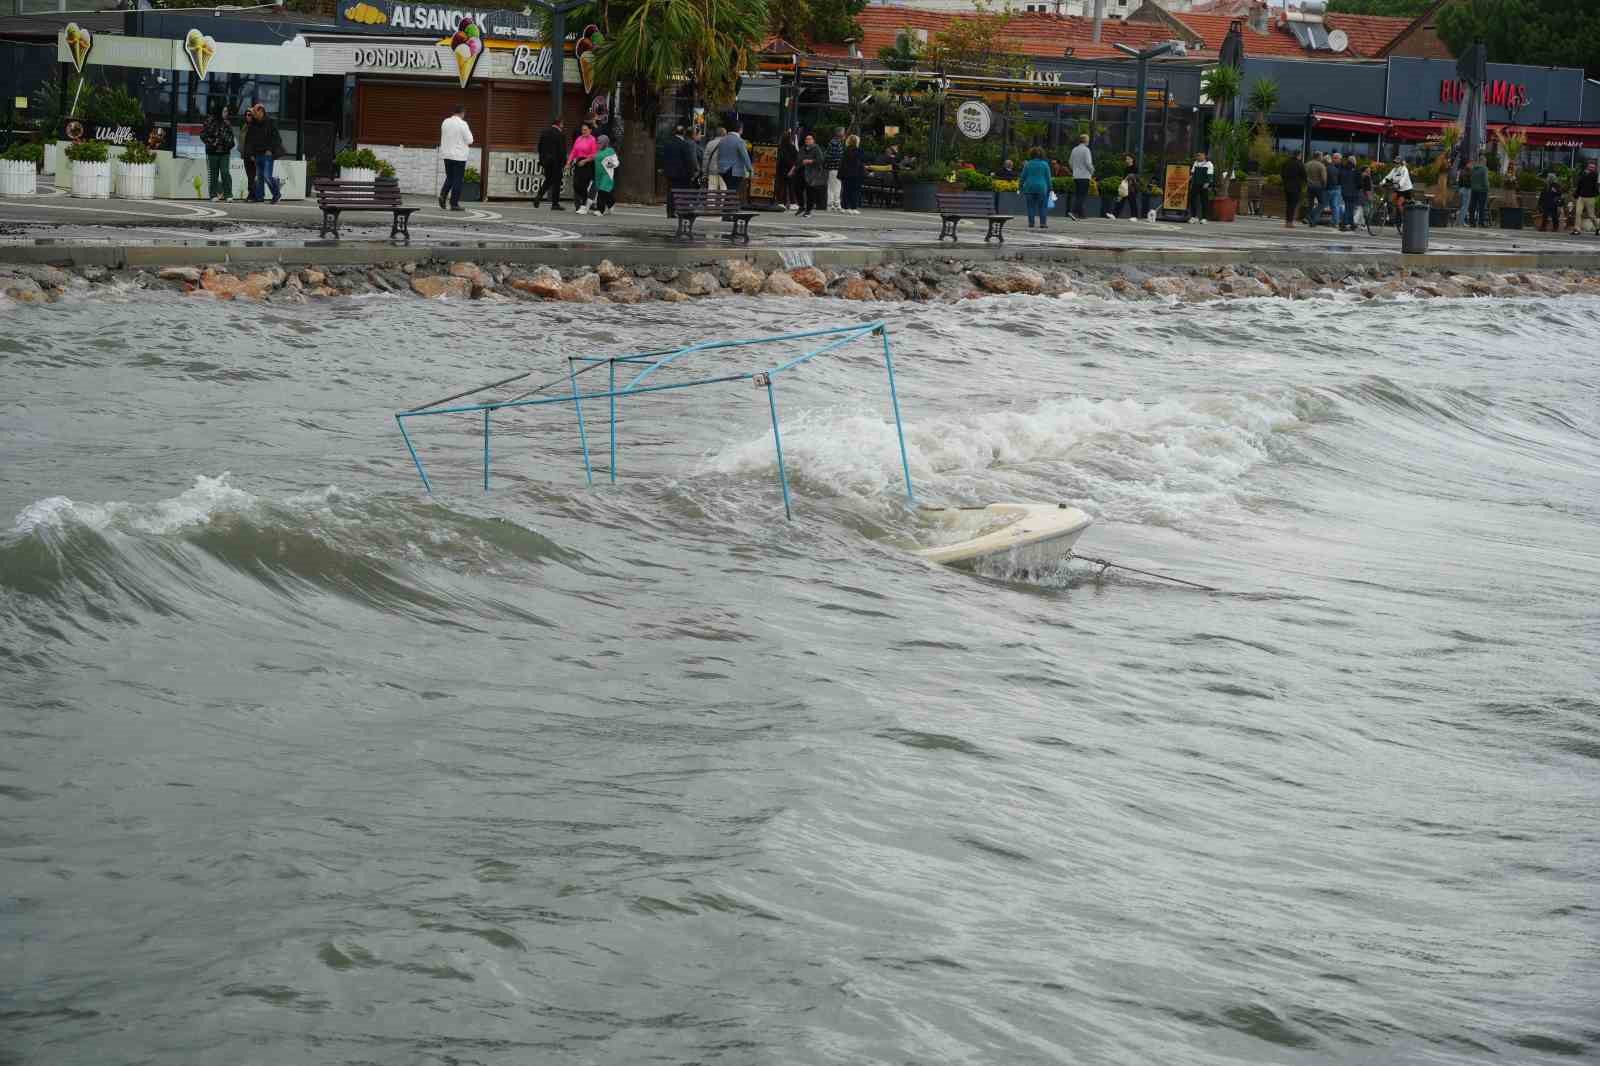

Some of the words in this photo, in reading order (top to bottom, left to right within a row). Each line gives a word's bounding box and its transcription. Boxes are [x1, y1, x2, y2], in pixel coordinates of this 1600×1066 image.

[391, 6, 488, 34] ALSANCK
[353, 47, 441, 69] DONDURMA
[95, 126, 134, 144] Waffle
